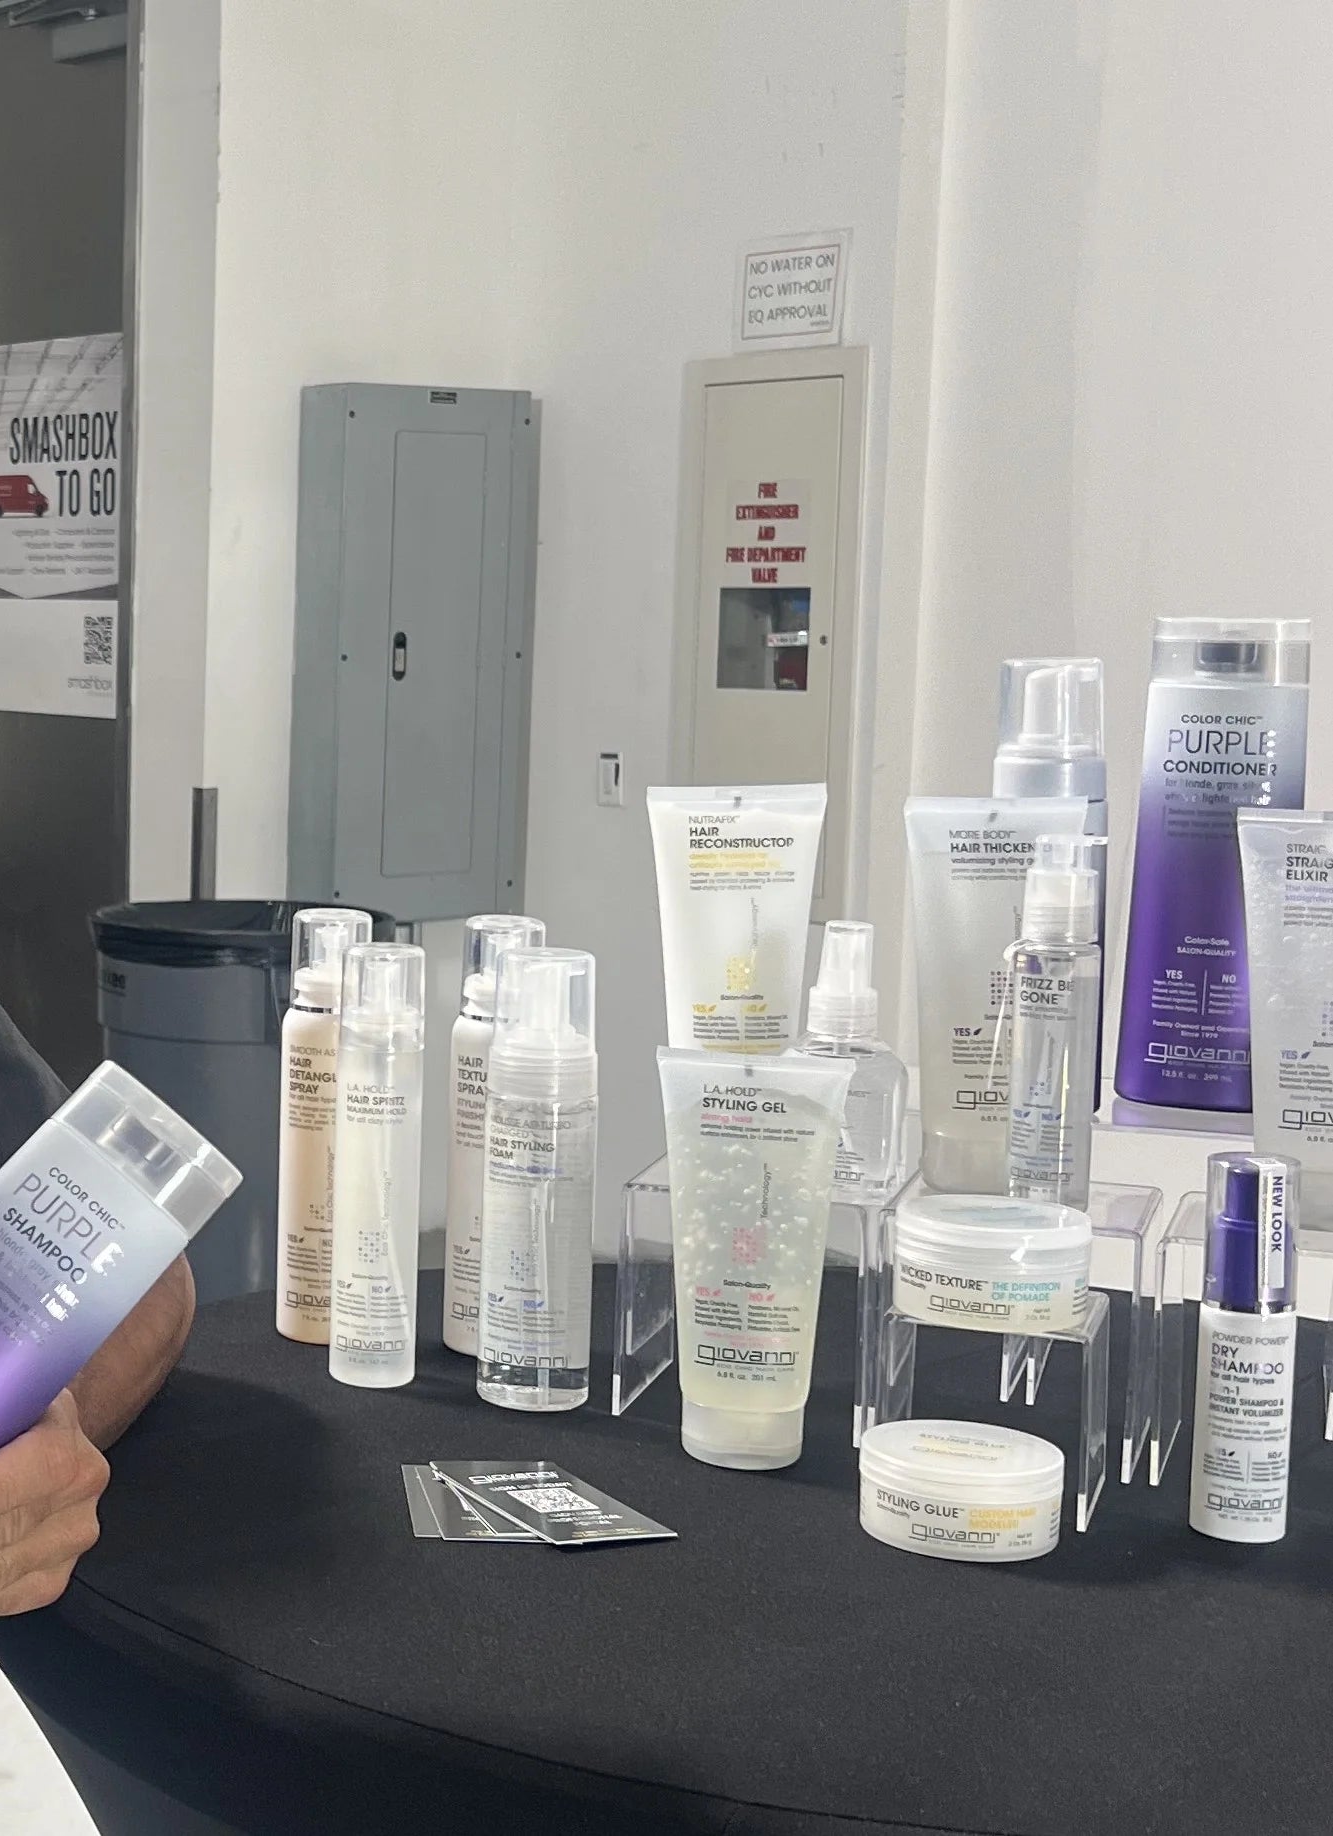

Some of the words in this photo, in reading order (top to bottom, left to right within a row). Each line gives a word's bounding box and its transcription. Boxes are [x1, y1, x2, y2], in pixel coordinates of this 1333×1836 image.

[750, 261, 768, 275] NO
[771, 255, 812, 272] WATER
[816, 253, 836, 268] ON
[748, 284, 774, 299] CYC
[777, 278, 833, 296] WITHOUT
[748, 310, 764, 325] EQ
[767, 304, 828, 321] APPROVAL
[9, 411, 118, 465] SMASHBOX
[55, 469, 81, 517] TO
[90, 467, 115, 517] GO
[758, 482, 777, 499] FIRE
[736, 504, 799, 520] EXTINGUISHER
[757, 526, 775, 541] AND
[726, 547, 746, 563] FIRE
[747, 546, 806, 563] DEPARTMENT
[752, 568, 778, 583] VALVE
[1181, 714, 1221, 725] COLOR
[1225, 715, 1257, 726] CHIC
[1168, 729, 1276, 758] PURPLE
[1163, 760, 1277, 776] CONDITIONER
[688, 815, 736, 824] NUTRAFIX
[690, 827, 719, 837] HAIR
[949, 830, 980, 839] MORE
[983, 830, 1011, 839] BODY
[690, 837, 794, 848] RECONSTRUCTOR
[950, 842, 980, 853] HAIR
[983, 843, 1035, 854] THICKEN
[951, 857, 996, 865] volumizing
[998, 857, 1024, 865] styling
[1286, 856, 1333, 870] STRAIG
[1286, 869, 1328, 882] ELIXIR
[1177, 946, 1237, 957] SALON-QUALITY
[1165, 970, 1183, 979] YES
[1222, 974, 1237, 983] NO
[1021, 976, 1053, 991] FRIZZ
[1058, 978, 1074, 991] BE
[1020, 991, 1058, 1005] GONE
[953, 1028, 971, 1037] YES
[290, 1044, 322, 1056] SMOOTH
[1281, 1050, 1298, 1060] YES
[289, 1056, 312, 1069] HAIR
[457, 1056, 483, 1068] HAIR
[289, 1068, 337, 1083] DETANGL
[457, 1068, 487, 1083] TEXTU
[289, 1081, 319, 1094] SPRAY
[363, 1084, 389, 1094] HOLD
[703, 1084, 722, 1095] L.A.
[726, 1086, 757, 1097] HOLD
[347, 1095, 369, 1105] HAIR
[372, 1096, 405, 1106] SPRITZ
[702, 1097, 757, 1111] STYLING
[762, 1102, 787, 1113] GEL
[347, 1105, 384, 1115] MAXIMUM
[386, 1107, 407, 1116] HOLD
[490, 1136, 509, 1148] HAIR
[511, 1140, 555, 1152] STYLING
[489, 1147, 514, 1160] FOAM
[49, 1166, 89, 1203] COLOR
[88, 1200, 119, 1230] CHIC
[1272, 1175, 1284, 1208] NEW
[13, 1173, 124, 1277] PURPLE
[1271, 1212, 1283, 1253] LOOK
[3, 1207, 88, 1285] SHAMPOO
[723, 1279, 771, 1290] Salon-Quality
[900, 1263, 932, 1283] WICKED
[935, 1273, 984, 1291] TEXTURE
[992, 1282, 1009, 1291] THE
[1011, 1282, 1061, 1292] DEFINITION
[696, 1286, 709, 1296] YES
[991, 1293, 1006, 1301] OF
[1008, 1293, 1051, 1301] POMADE
[927, 1295, 1011, 1316] giovanni
[335, 1334, 406, 1353] giovanni
[1212, 1331, 1253, 1345] POWDER
[483, 1346, 568, 1368] giovanni
[694, 1344, 796, 1367] giovanni
[1212, 1343, 1239, 1358] DRY
[1211, 1356, 1284, 1375] SHAMPOO
[1253, 1377, 1275, 1386] types
[1209, 1392, 1237, 1405] POWER
[1239, 1398, 1278, 1407] SHAMPOO
[1209, 1403, 1239, 1415] INSTANT
[1242, 1408, 1284, 1417] VOLUMIZER
[469, 1471, 559, 1485] giovanni
[877, 1488, 920, 1512] STYLING
[924, 1503, 959, 1519] GLUE
[969, 1508, 1014, 1519] CUSTOM
[1016, 1507, 1036, 1517] HAIR
[908, 1523, 996, 1543] giovanni
